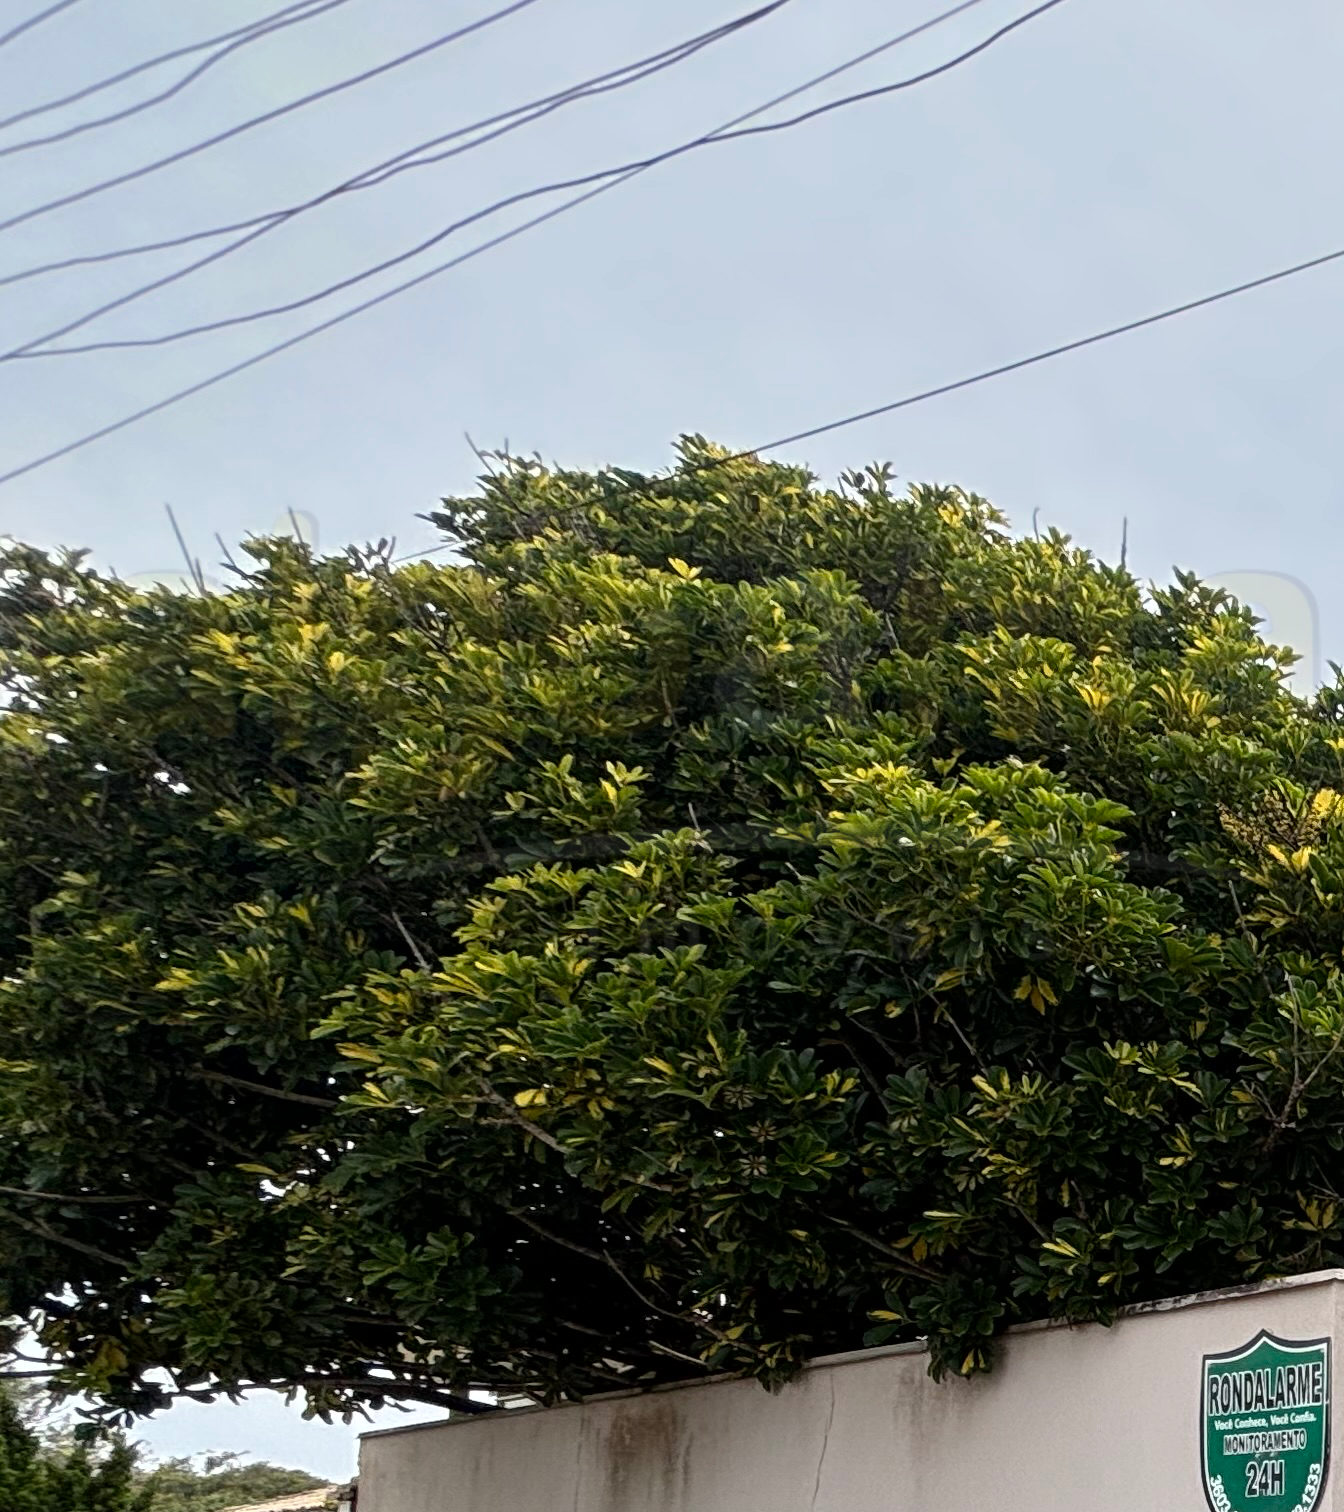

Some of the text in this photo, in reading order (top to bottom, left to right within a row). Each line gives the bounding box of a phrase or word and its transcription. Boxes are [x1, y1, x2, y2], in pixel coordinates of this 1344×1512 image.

[1208, 1362, 1322, 1416] RONDALARME
[1223, 1428, 1307, 1455] MONITORAMENTO
[1245, 1460, 1285, 1498] 24H
